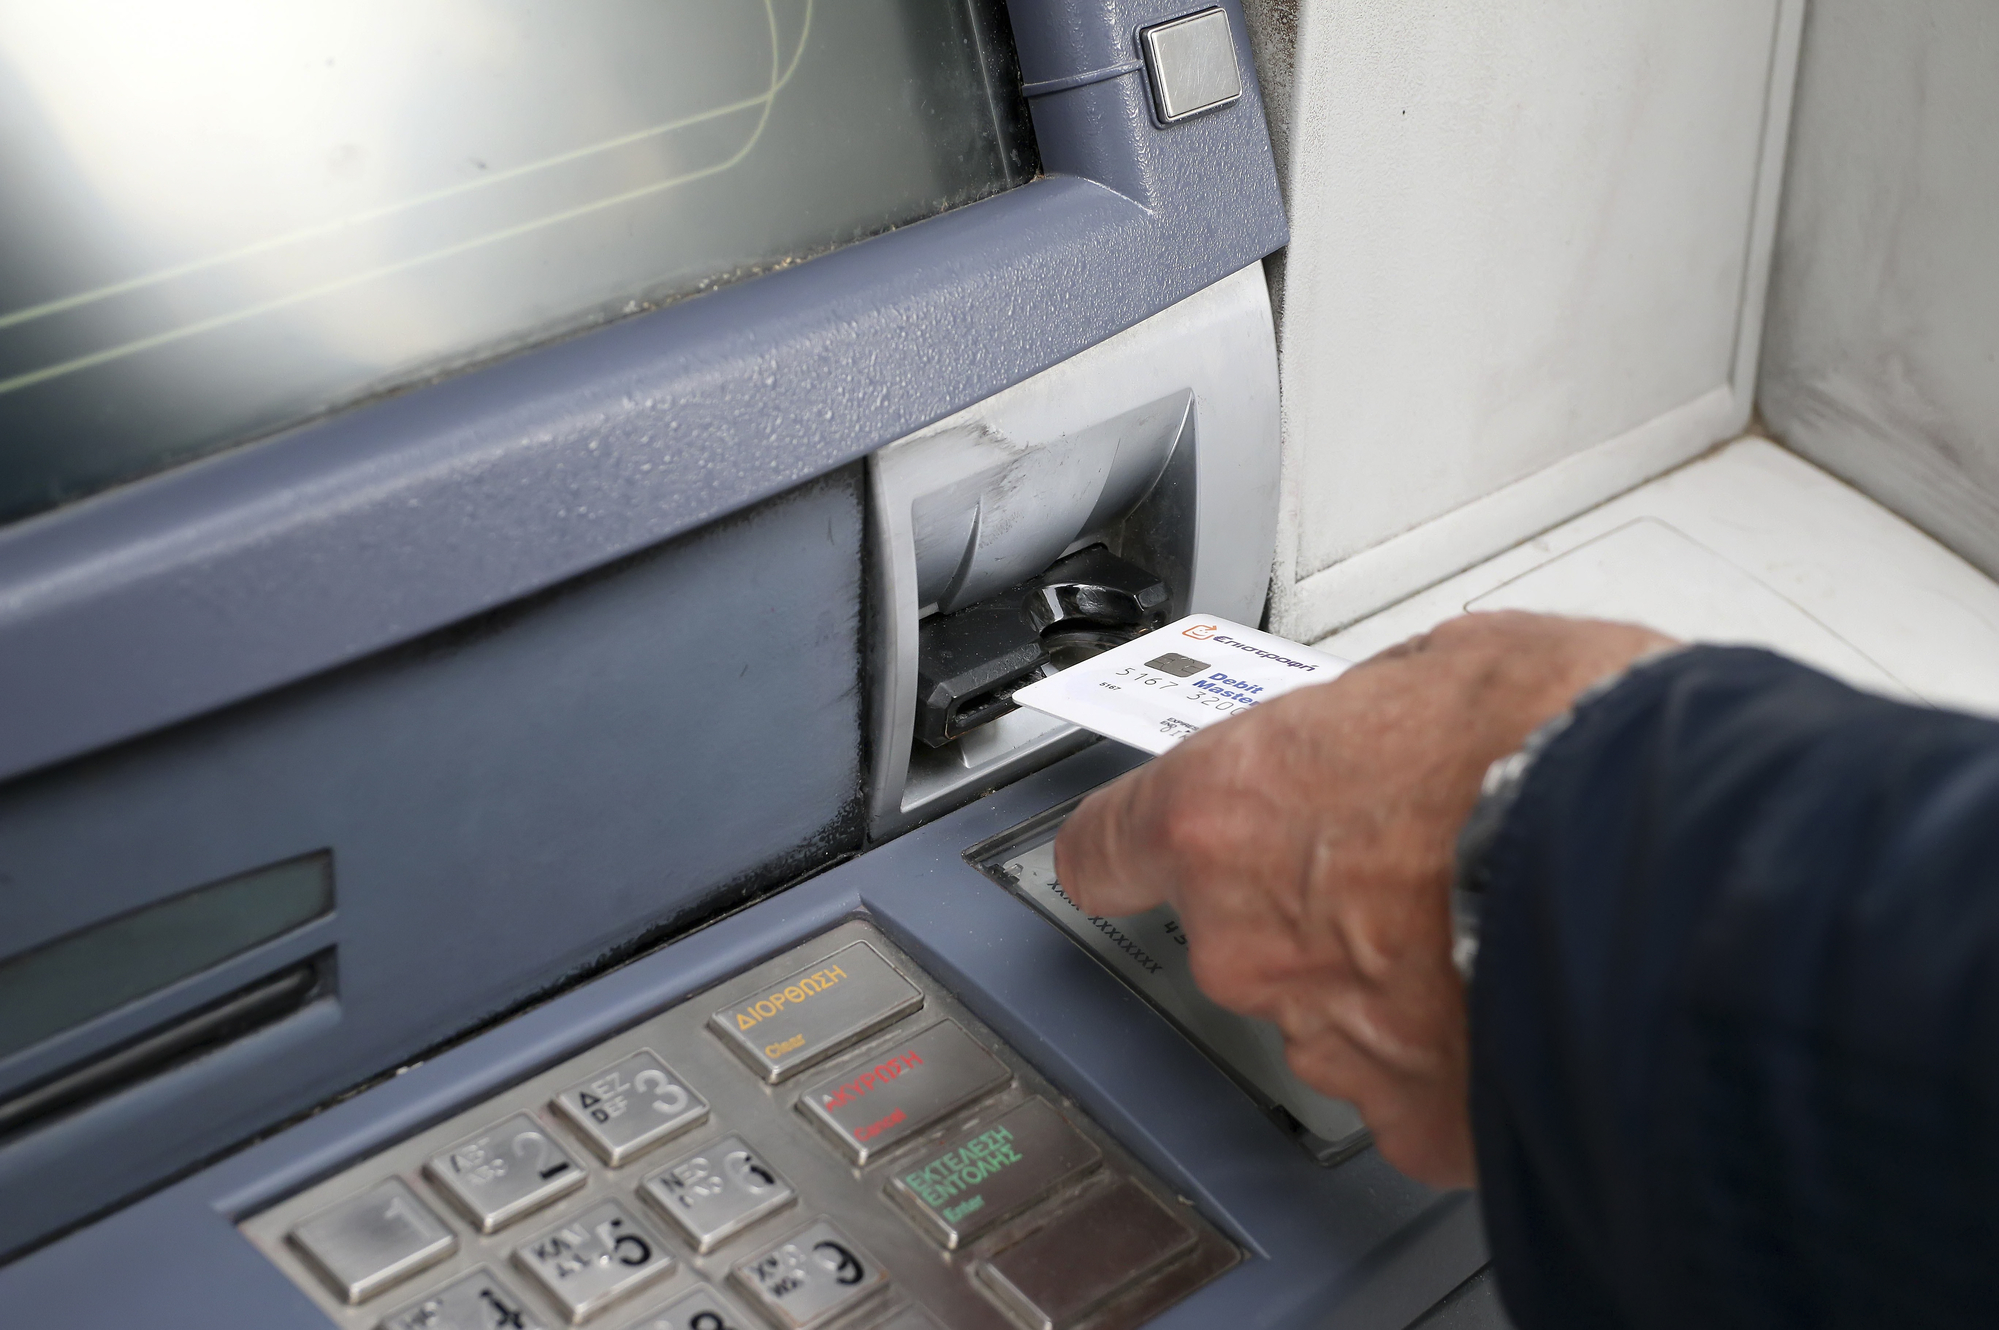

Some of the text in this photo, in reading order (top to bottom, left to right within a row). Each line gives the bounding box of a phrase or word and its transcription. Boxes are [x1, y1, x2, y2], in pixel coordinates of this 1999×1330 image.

[1115, 667, 1179, 690] 5167
[1208, 672, 1264, 694] Debit
[736, 965, 848, 1031] ΔΙΟΡΘΩΣΗ
[633, 1069, 689, 1115] 3
[824, 1049, 924, 1113] ΑΚΥΡΩΣΗ
[512, 1131, 570, 1179] 2
[723, 1150, 776, 1195] 6
[906, 1125, 1014, 1192] ΕΚΤΕΛΕΣΗ
[921, 1143, 1023, 1207] ΕΝΤΟΛΗΣ
[595, 1217, 652, 1268] 5
[811, 1239, 865, 1286] 9
